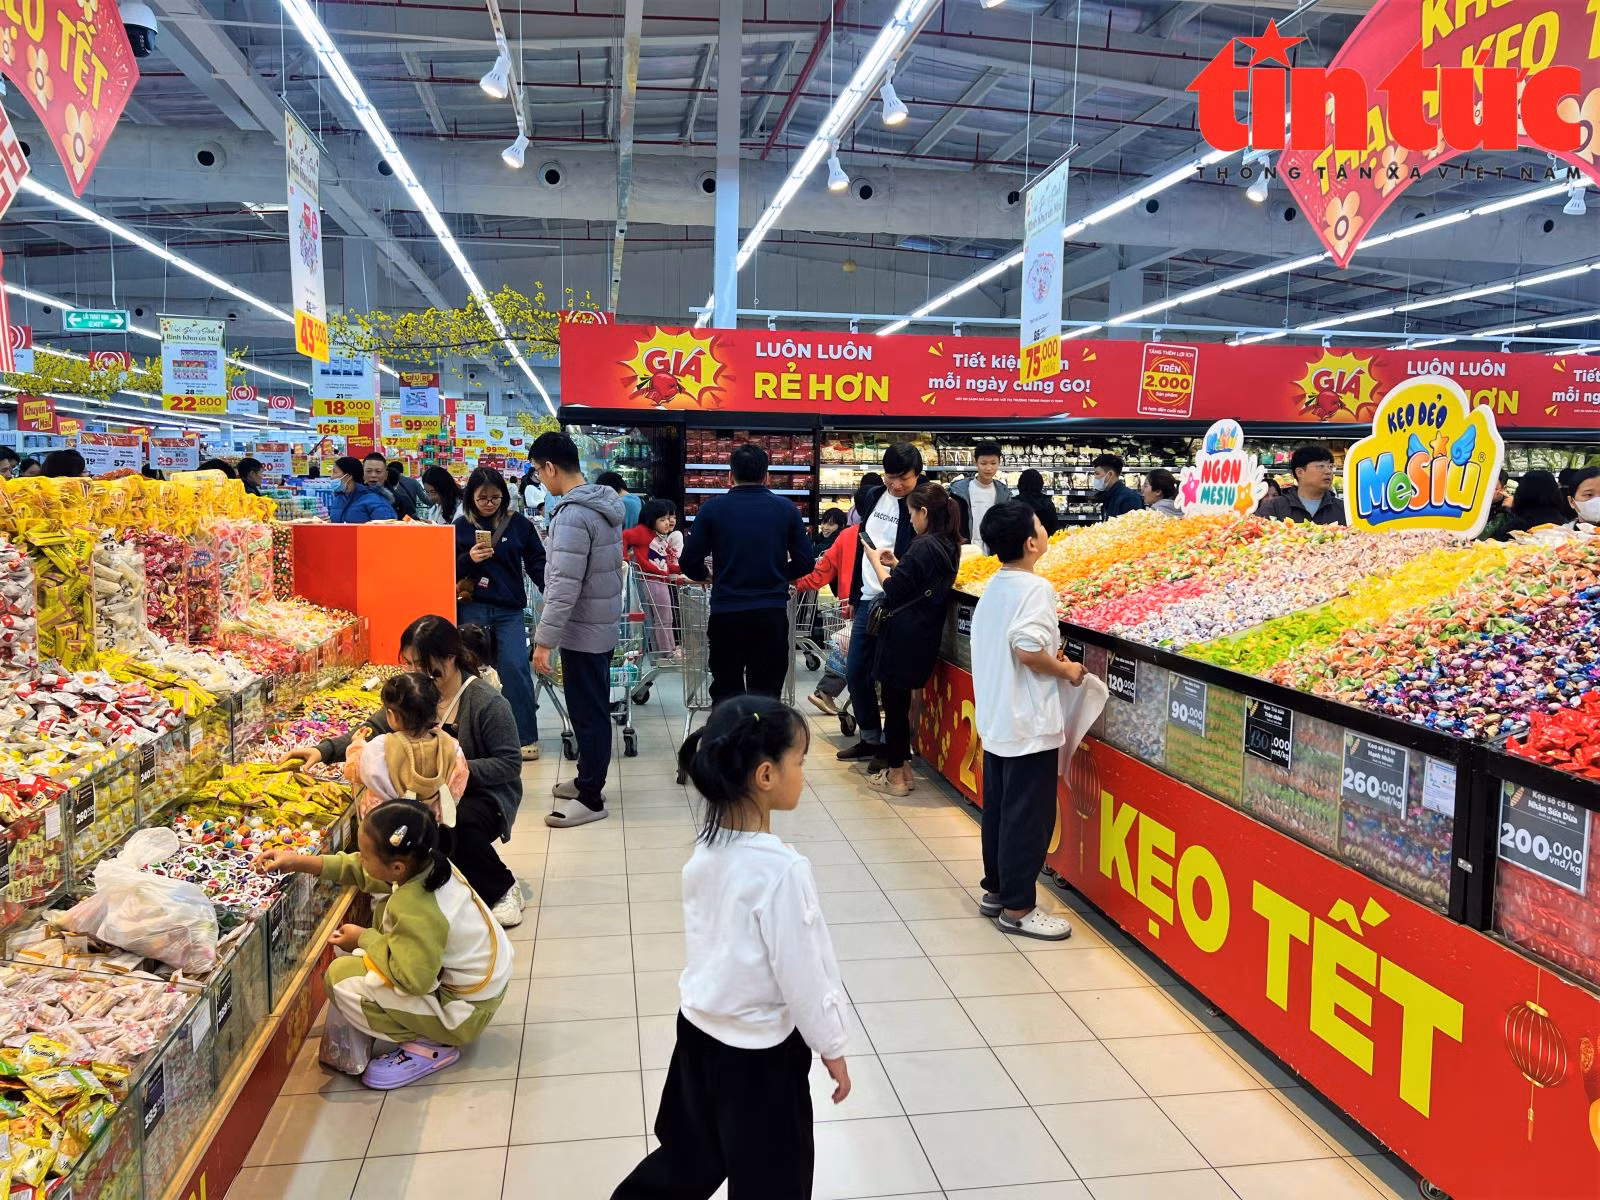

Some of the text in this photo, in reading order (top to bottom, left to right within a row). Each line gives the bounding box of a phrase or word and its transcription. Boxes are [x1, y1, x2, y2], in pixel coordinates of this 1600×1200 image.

[57, 9, 109, 111] TẾT
[755, 339, 872, 361] LUÔN LUÔN
[953, 351, 986, 369] Tiết
[1026, 339, 1058, 379] 75.000
[643, 346, 707, 381] GIÁ
[1159, 363, 1181, 373] TRÊN
[1407, 357, 1506, 378] LUÔN LUÔN
[754, 361, 889, 402] RẺ HƠN
[928, 371, 960, 391] mỗi
[966, 376, 1007, 393] ngày
[1059, 379, 1091, 393] GO!
[1144, 374, 1190, 391] 2.000
[1312, 368, 1365, 396] GIÁ
[169, 396, 222, 412] 22.800
[1552, 386, 1580, 402] mỗi
[324, 400, 371, 415] 18.000
[1387, 394, 1447, 435] KẸO DẺO
[1201, 458, 1242, 484] NGON
[1200, 485, 1236, 506] MESIU
[1171, 700, 1203, 722] 90.000
[1343, 767, 1403, 798] 260.000
[1528, 799, 1547, 813] Nhân
[1532, 790, 1546, 802] Kẹo
[1500, 822, 1583, 865] 200.000
[1549, 855, 1582, 874] vnđ/kg
[1099, 790, 1464, 1118] KẸO TẾT
